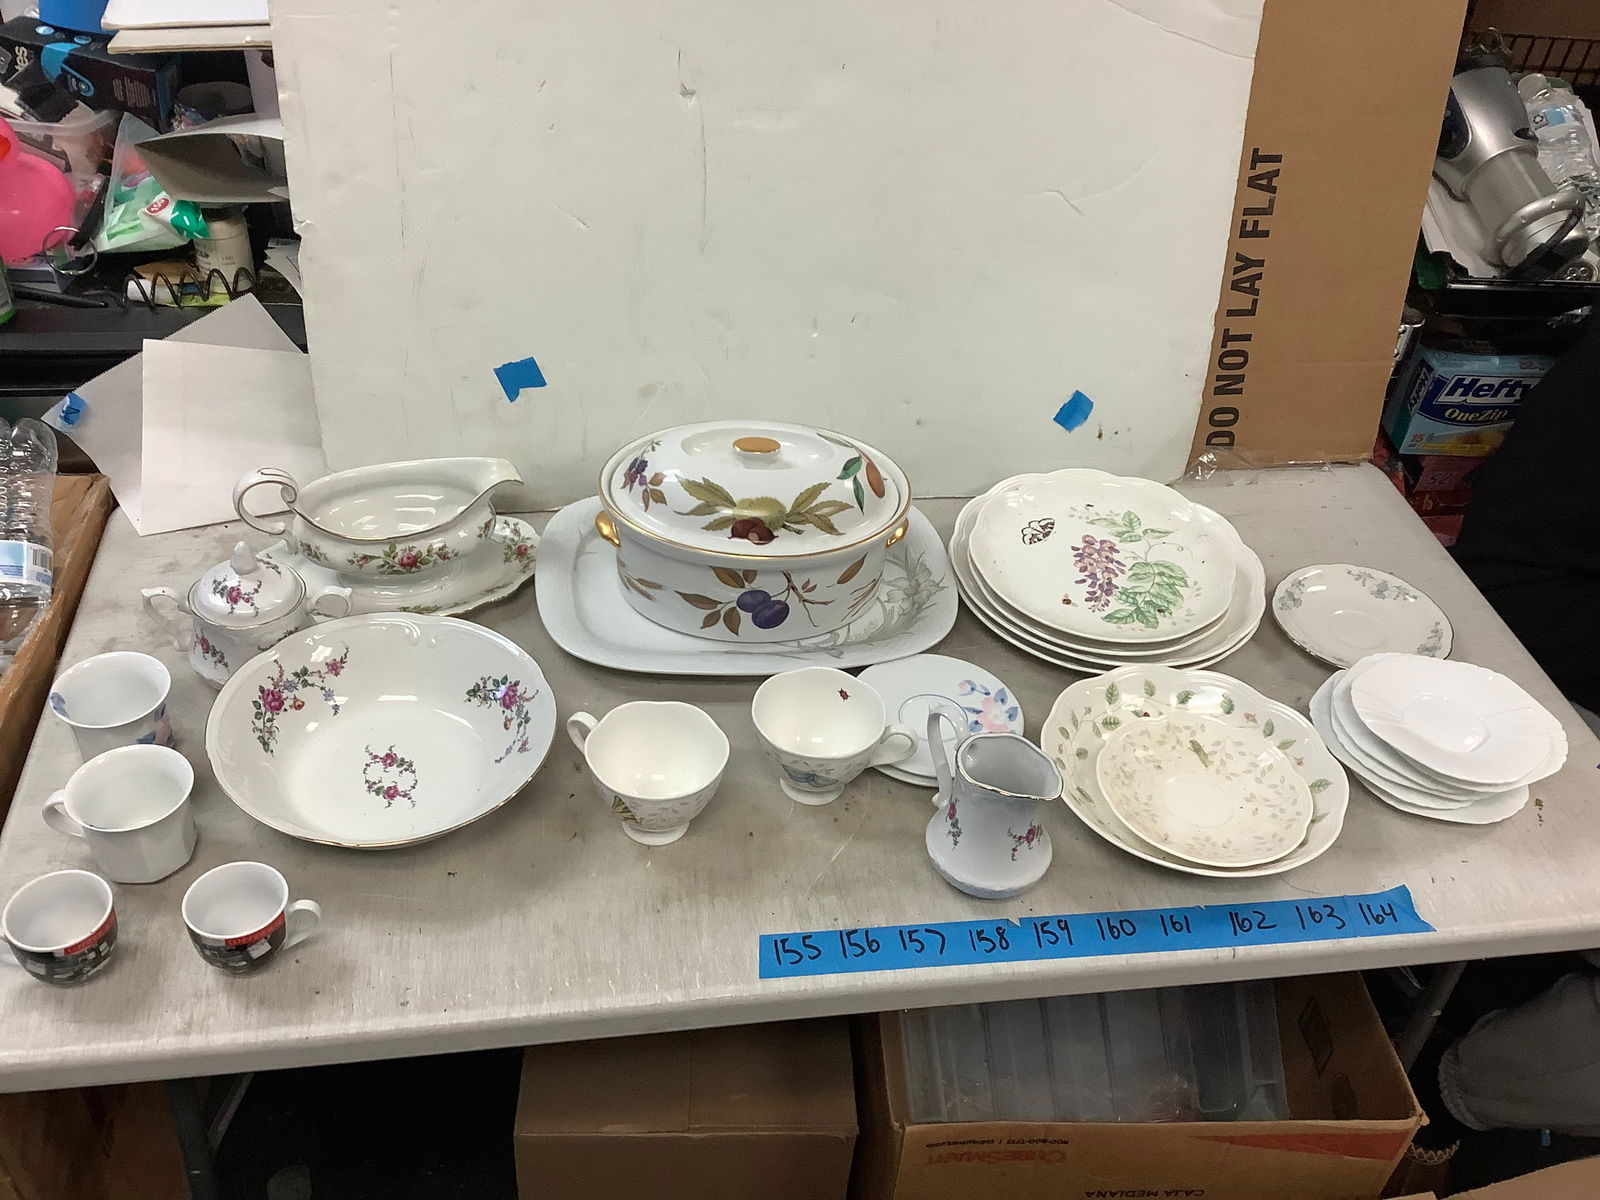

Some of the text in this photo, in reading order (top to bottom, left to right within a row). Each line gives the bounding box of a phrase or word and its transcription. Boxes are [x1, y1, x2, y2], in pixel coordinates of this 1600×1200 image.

[1205, 148, 1283, 449] DO NOT LAY FLAT
[774, 902, 1398, 966] 155 156 157 158 159 160 161 162 163 164
[1085, 1189, 1206, 1198] CAJA MEDIANA
